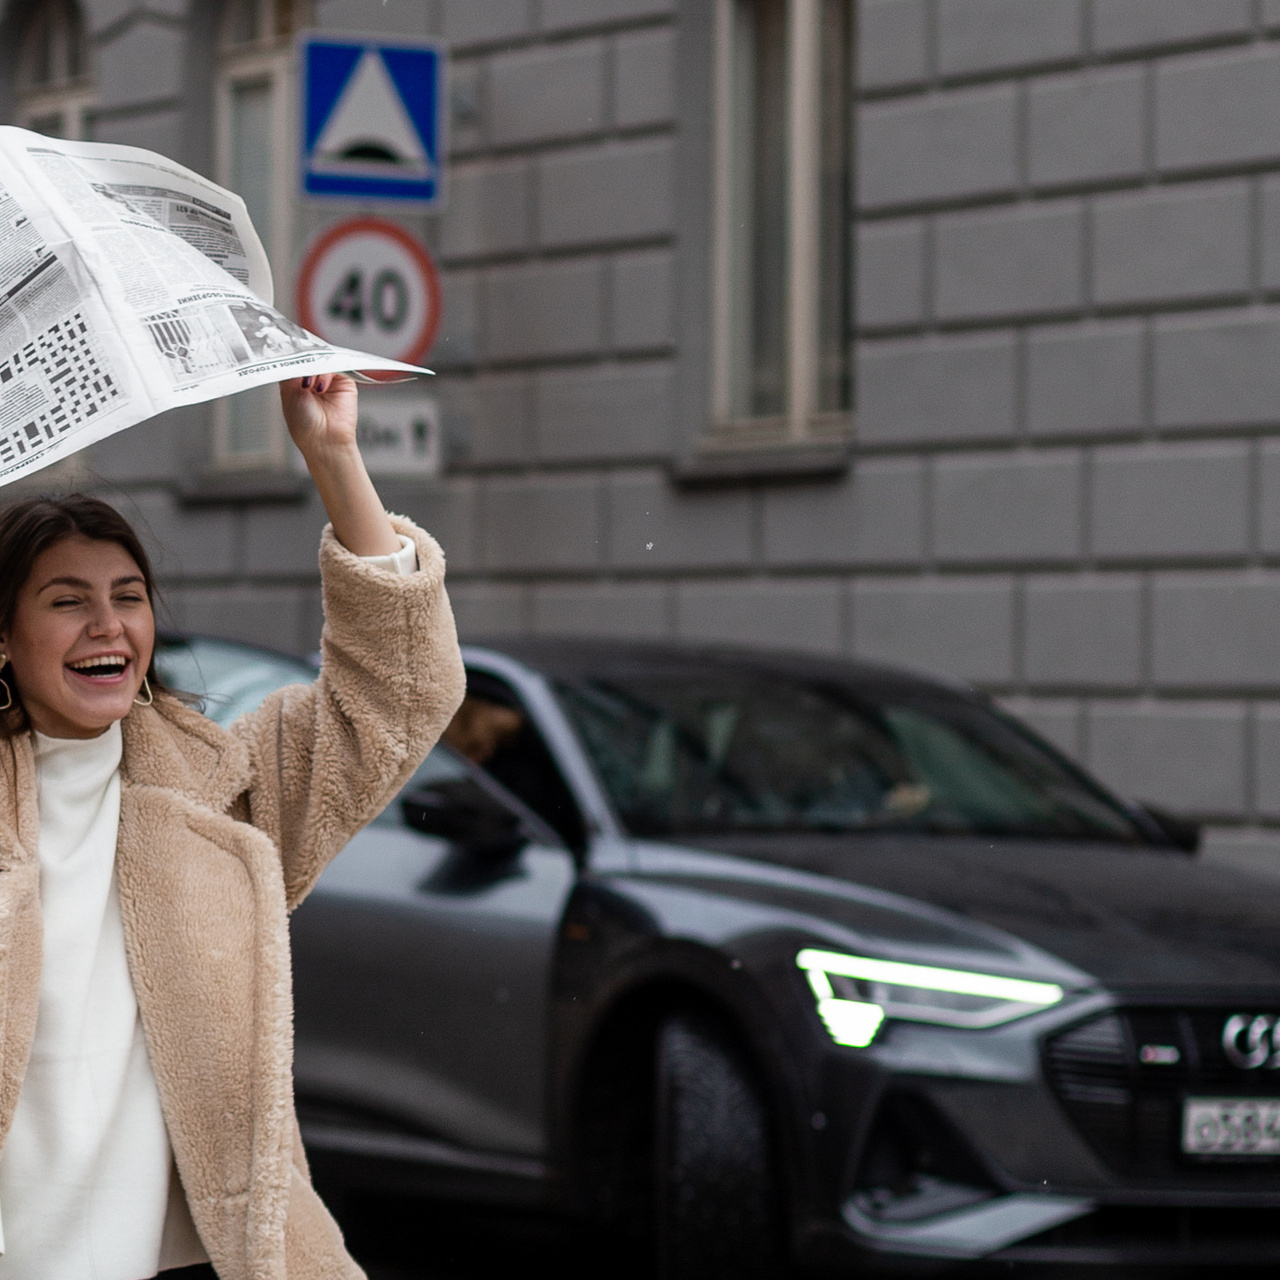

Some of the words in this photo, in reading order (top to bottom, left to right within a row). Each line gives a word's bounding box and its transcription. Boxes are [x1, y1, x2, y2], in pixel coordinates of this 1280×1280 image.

[326, 266, 411, 334] 40
[280, 357, 315, 368] ГЛАВНОЕ
[238, 365, 270, 377] ГОРОДЕ
